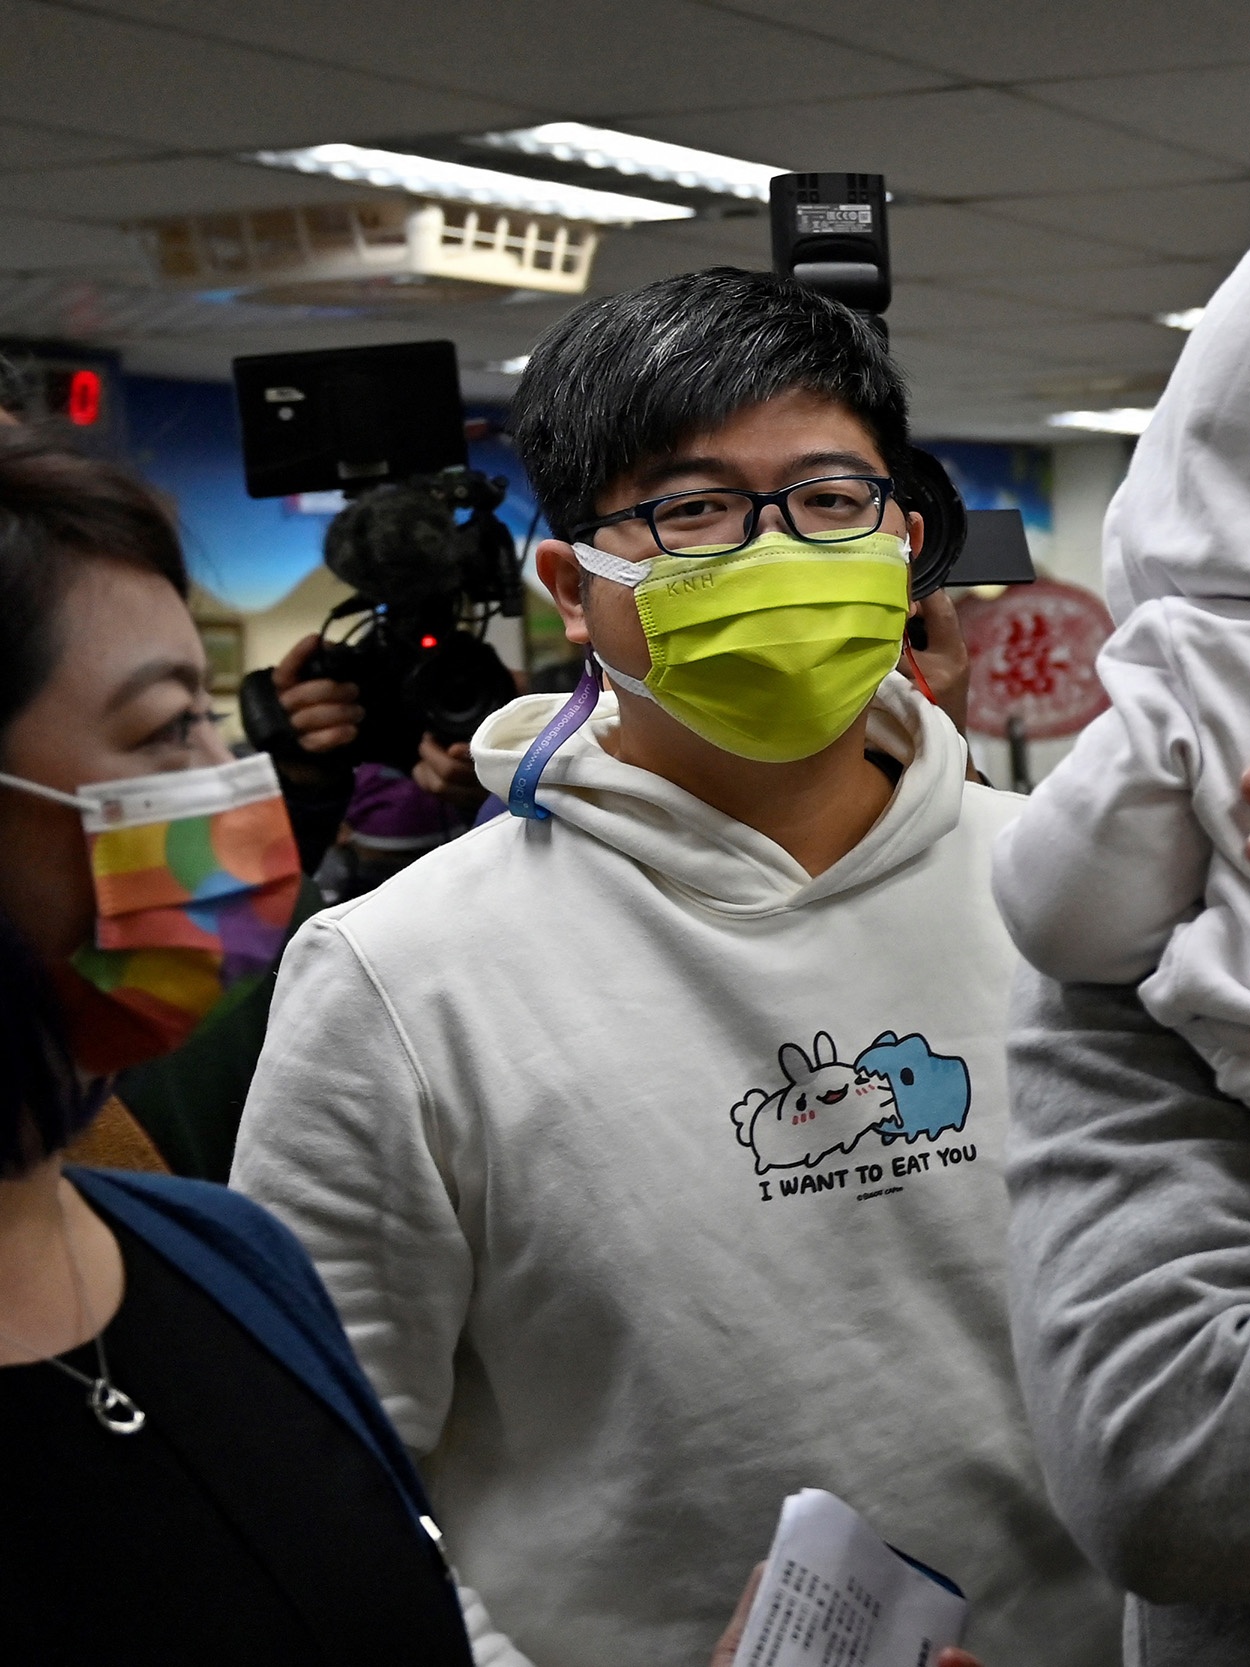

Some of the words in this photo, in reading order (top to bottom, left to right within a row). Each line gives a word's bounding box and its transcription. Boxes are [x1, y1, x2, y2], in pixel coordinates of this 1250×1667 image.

[665, 573, 715, 598] KNH
[524, 683, 592, 772] www.gagaoolala.com
[759, 1181, 772, 1201] I
[780, 1169, 849, 1198] WANT
[855, 1165, 883, 1185] TO
[892, 1153, 931, 1177] EAT
[936, 1144, 977, 1167] YOU
